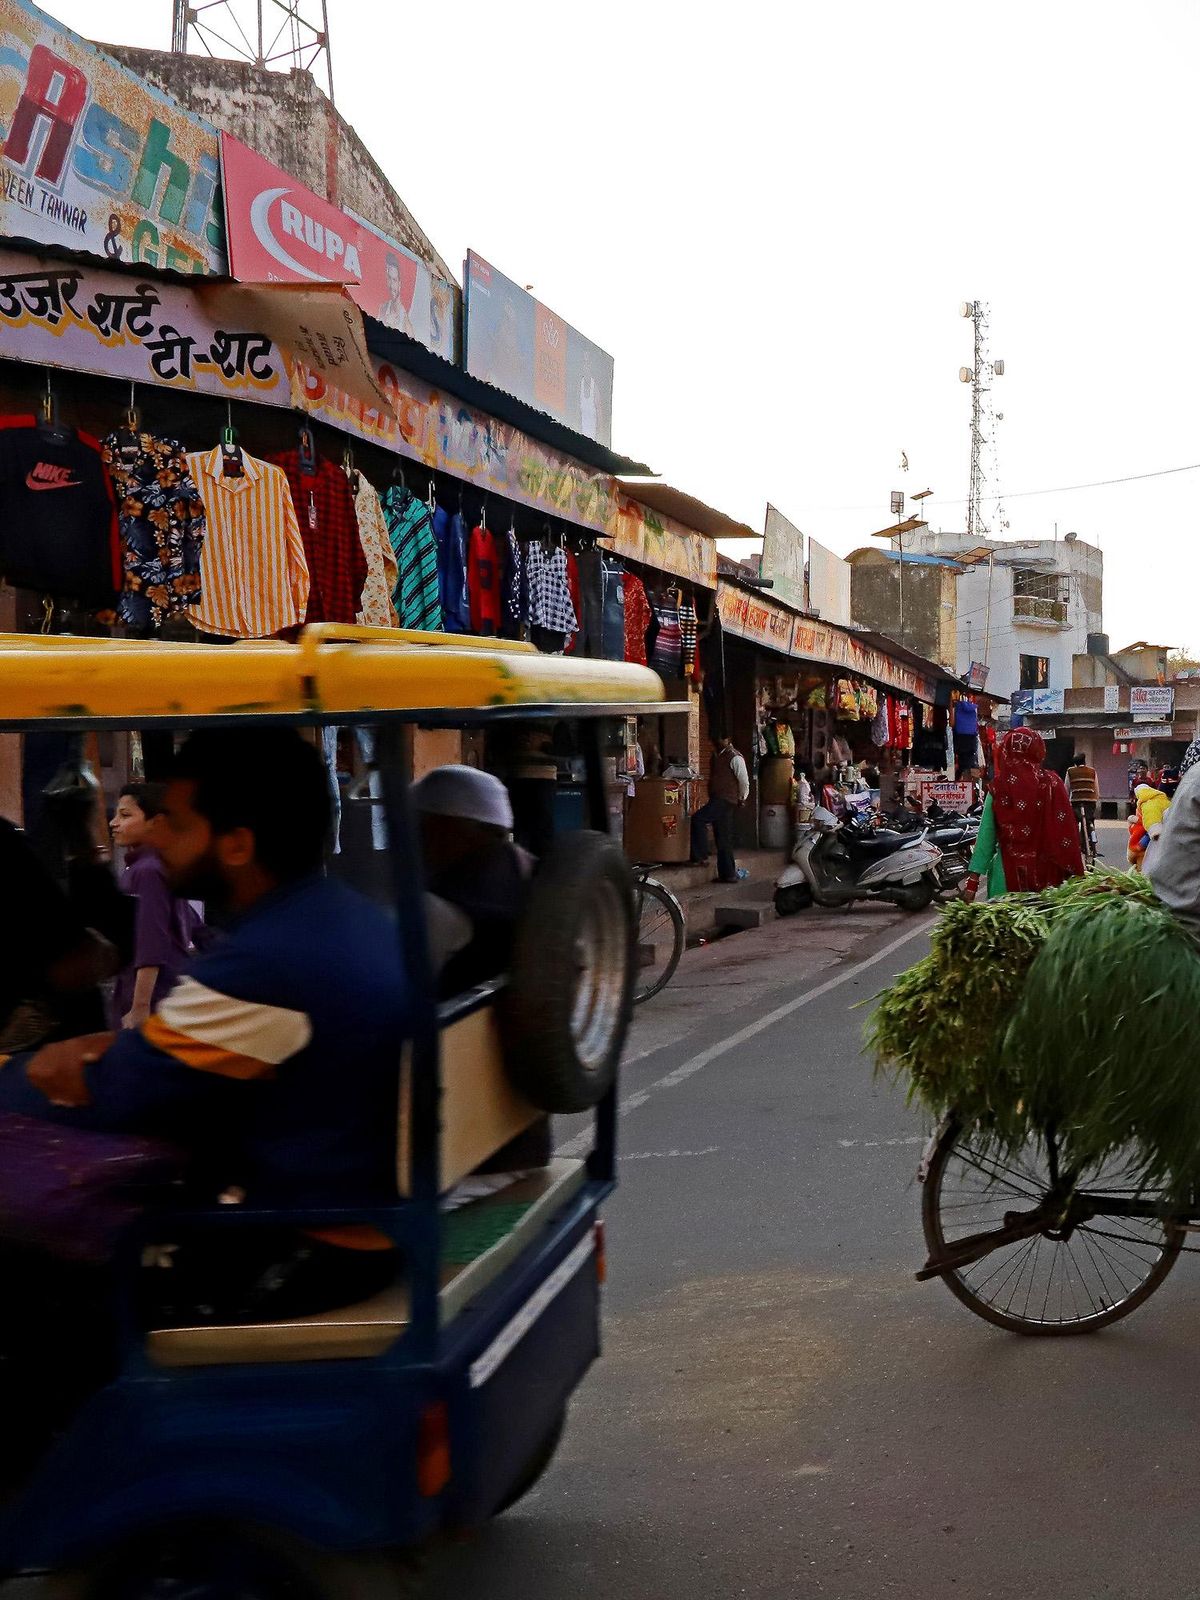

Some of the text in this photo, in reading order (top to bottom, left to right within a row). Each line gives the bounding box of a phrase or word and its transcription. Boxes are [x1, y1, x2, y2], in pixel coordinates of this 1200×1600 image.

[41, 190, 87, 235] TANWAR
[280, 199, 363, 280] RUPA
[87, 283, 162, 338] शर्ट
[32, 461, 72, 483] NIKE
